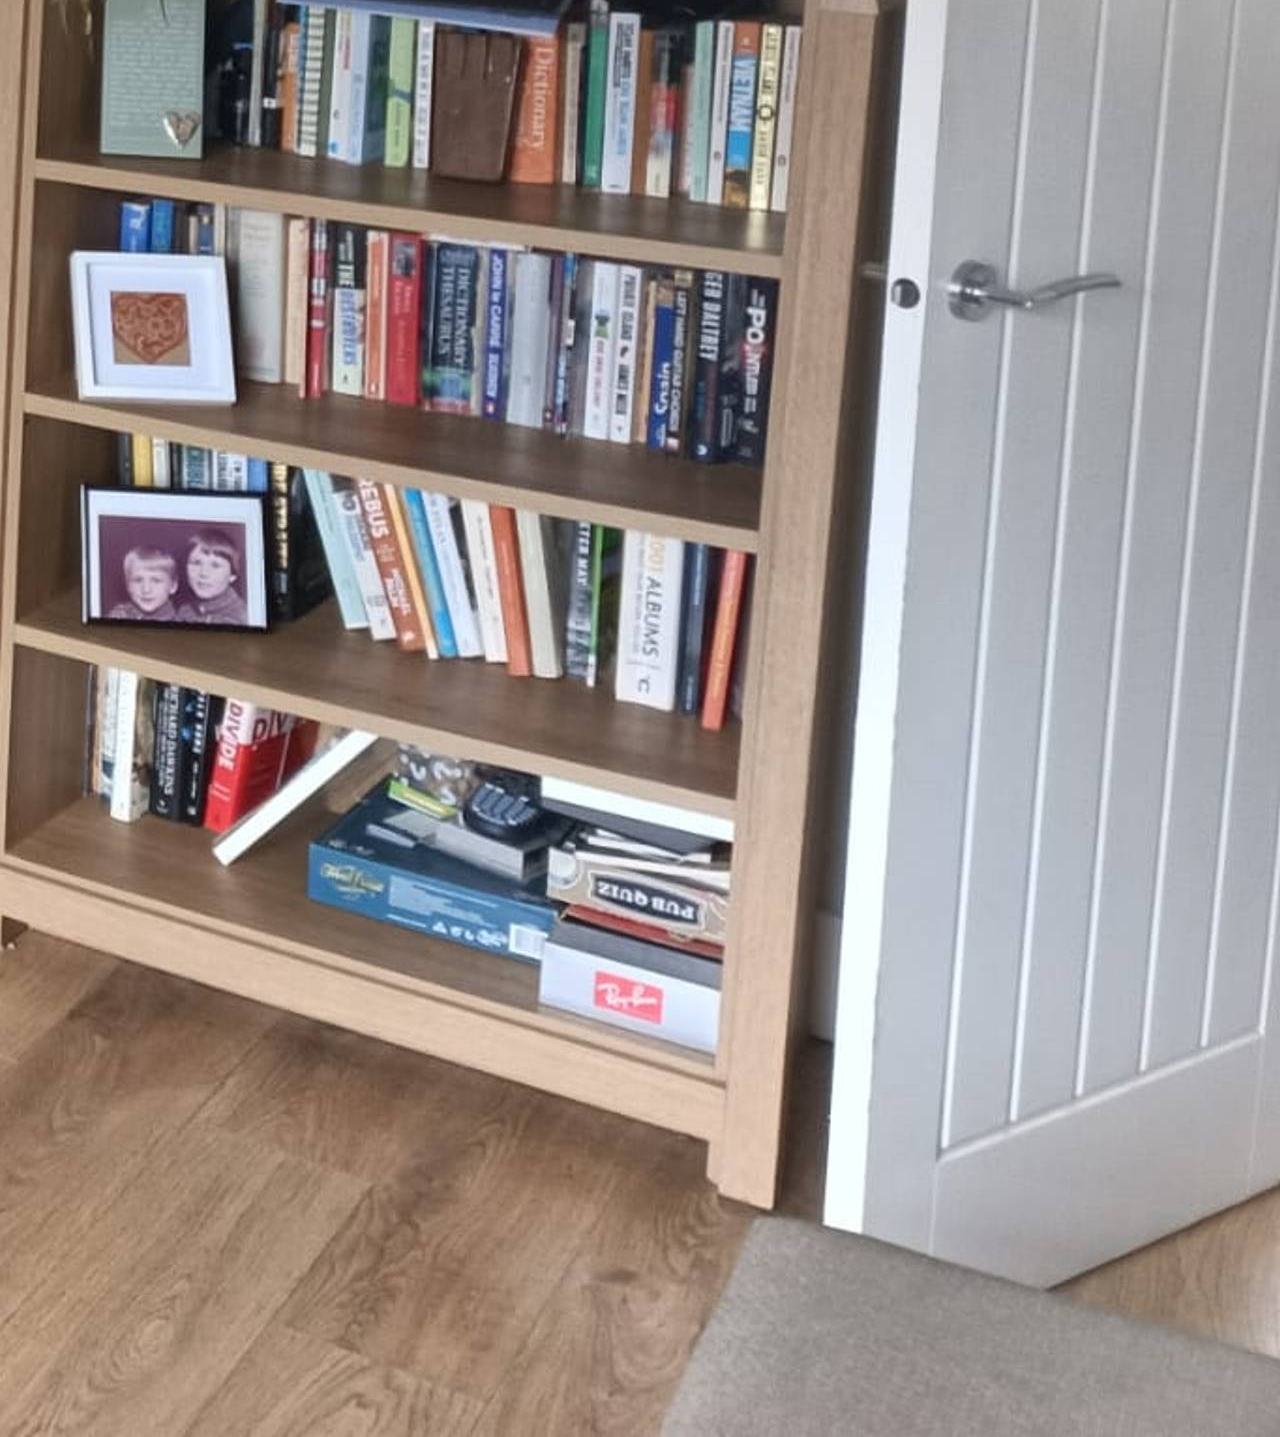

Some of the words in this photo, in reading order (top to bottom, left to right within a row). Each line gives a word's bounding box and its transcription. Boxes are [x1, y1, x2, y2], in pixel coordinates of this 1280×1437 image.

[528, 46, 556, 150] Dictionary
[730, 56, 757, 130] VIETNAM
[338, 264, 355, 288] THE
[492, 253, 504, 292] JOHN
[438, 266, 455, 355] THESAURUS
[454, 266, 471, 365] DICTIONARY
[676, 291, 688, 315] LEFT
[620, 310, 634, 341] ISLAND
[674, 315, 686, 347] HAND
[699, 301, 722, 362] DALTREY
[671, 349, 684, 387] GUITAR
[668, 389, 682, 433] CHORDS
[642, 576, 662, 658] ALBUMS
[218, 702, 244, 772] DIVIDE
[597, 881, 649, 906] QUIZ
[650, 900, 696, 921] PUB
